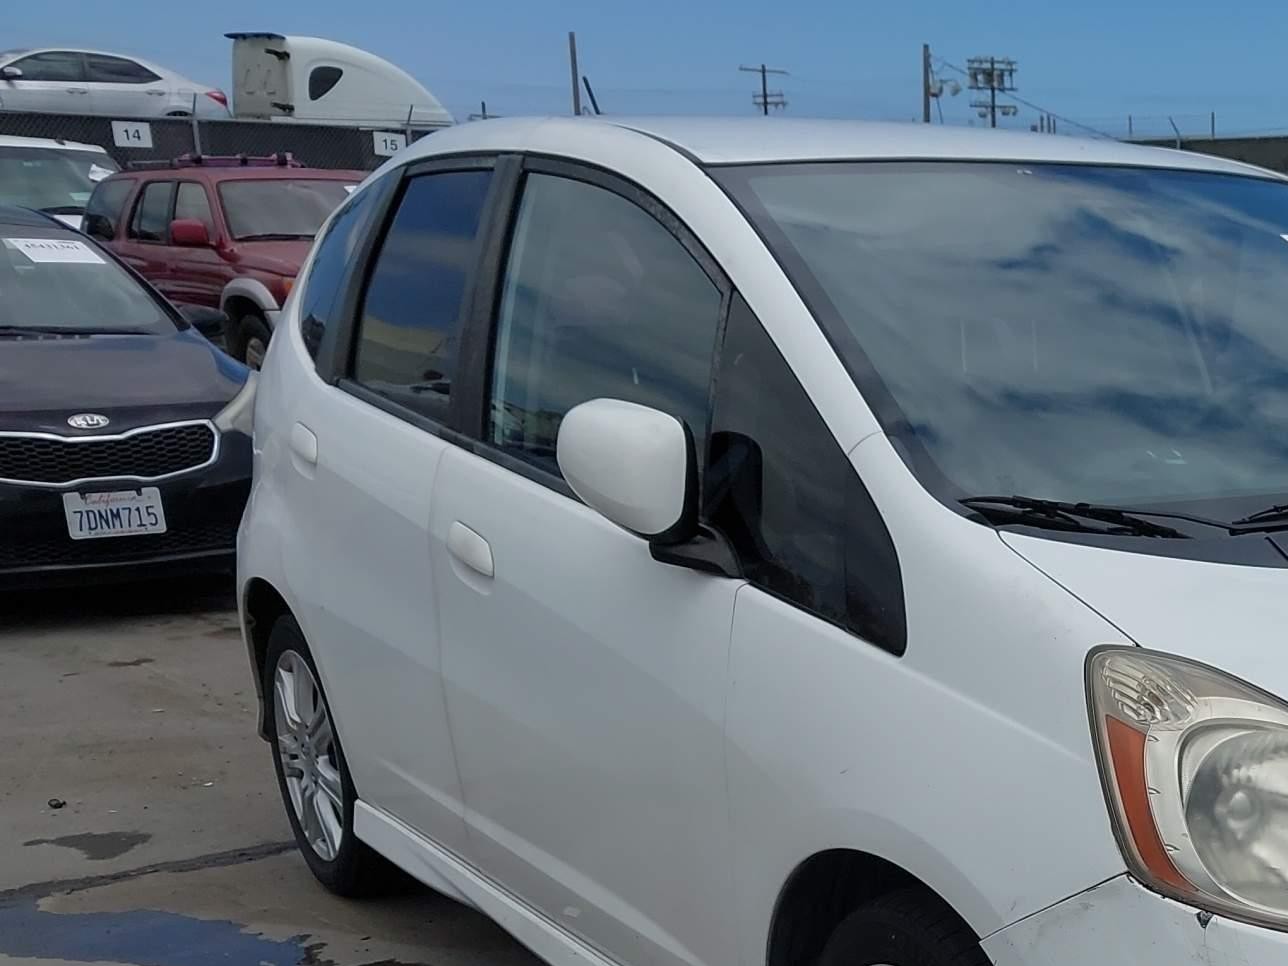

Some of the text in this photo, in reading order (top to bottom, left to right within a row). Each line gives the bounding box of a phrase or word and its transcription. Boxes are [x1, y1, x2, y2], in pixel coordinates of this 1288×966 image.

[122, 128, 142, 141] 14
[382, 138, 399, 151] 15
[73, 505, 159, 532] 7DNM715
